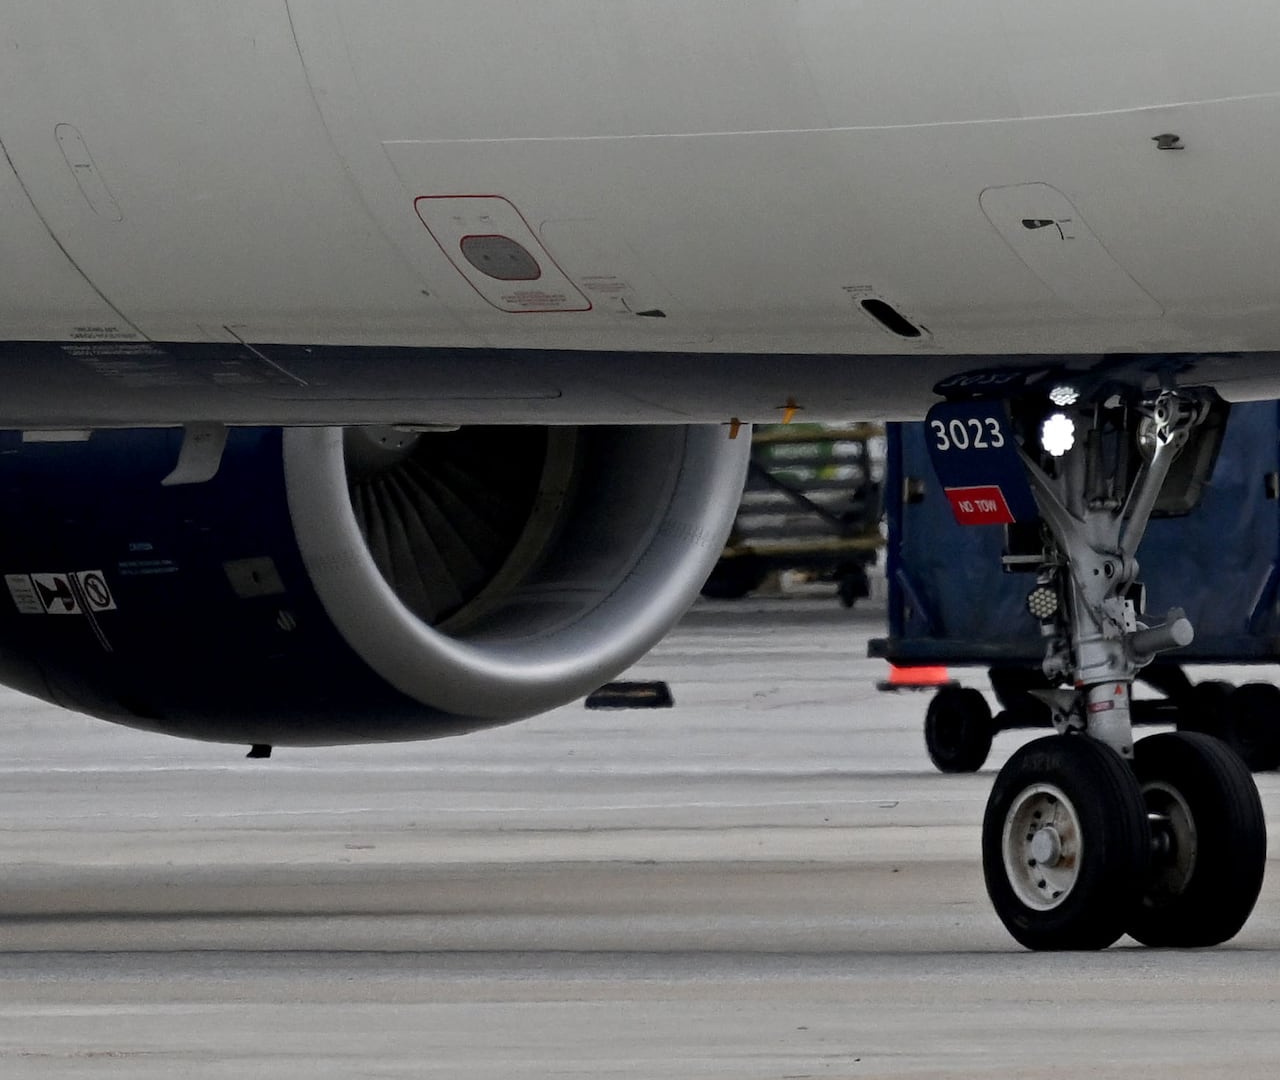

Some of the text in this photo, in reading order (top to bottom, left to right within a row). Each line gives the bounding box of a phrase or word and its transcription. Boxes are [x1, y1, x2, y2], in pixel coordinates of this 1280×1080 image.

[931, 417, 1005, 451] 3023
[958, 499, 998, 513] NO TOW
